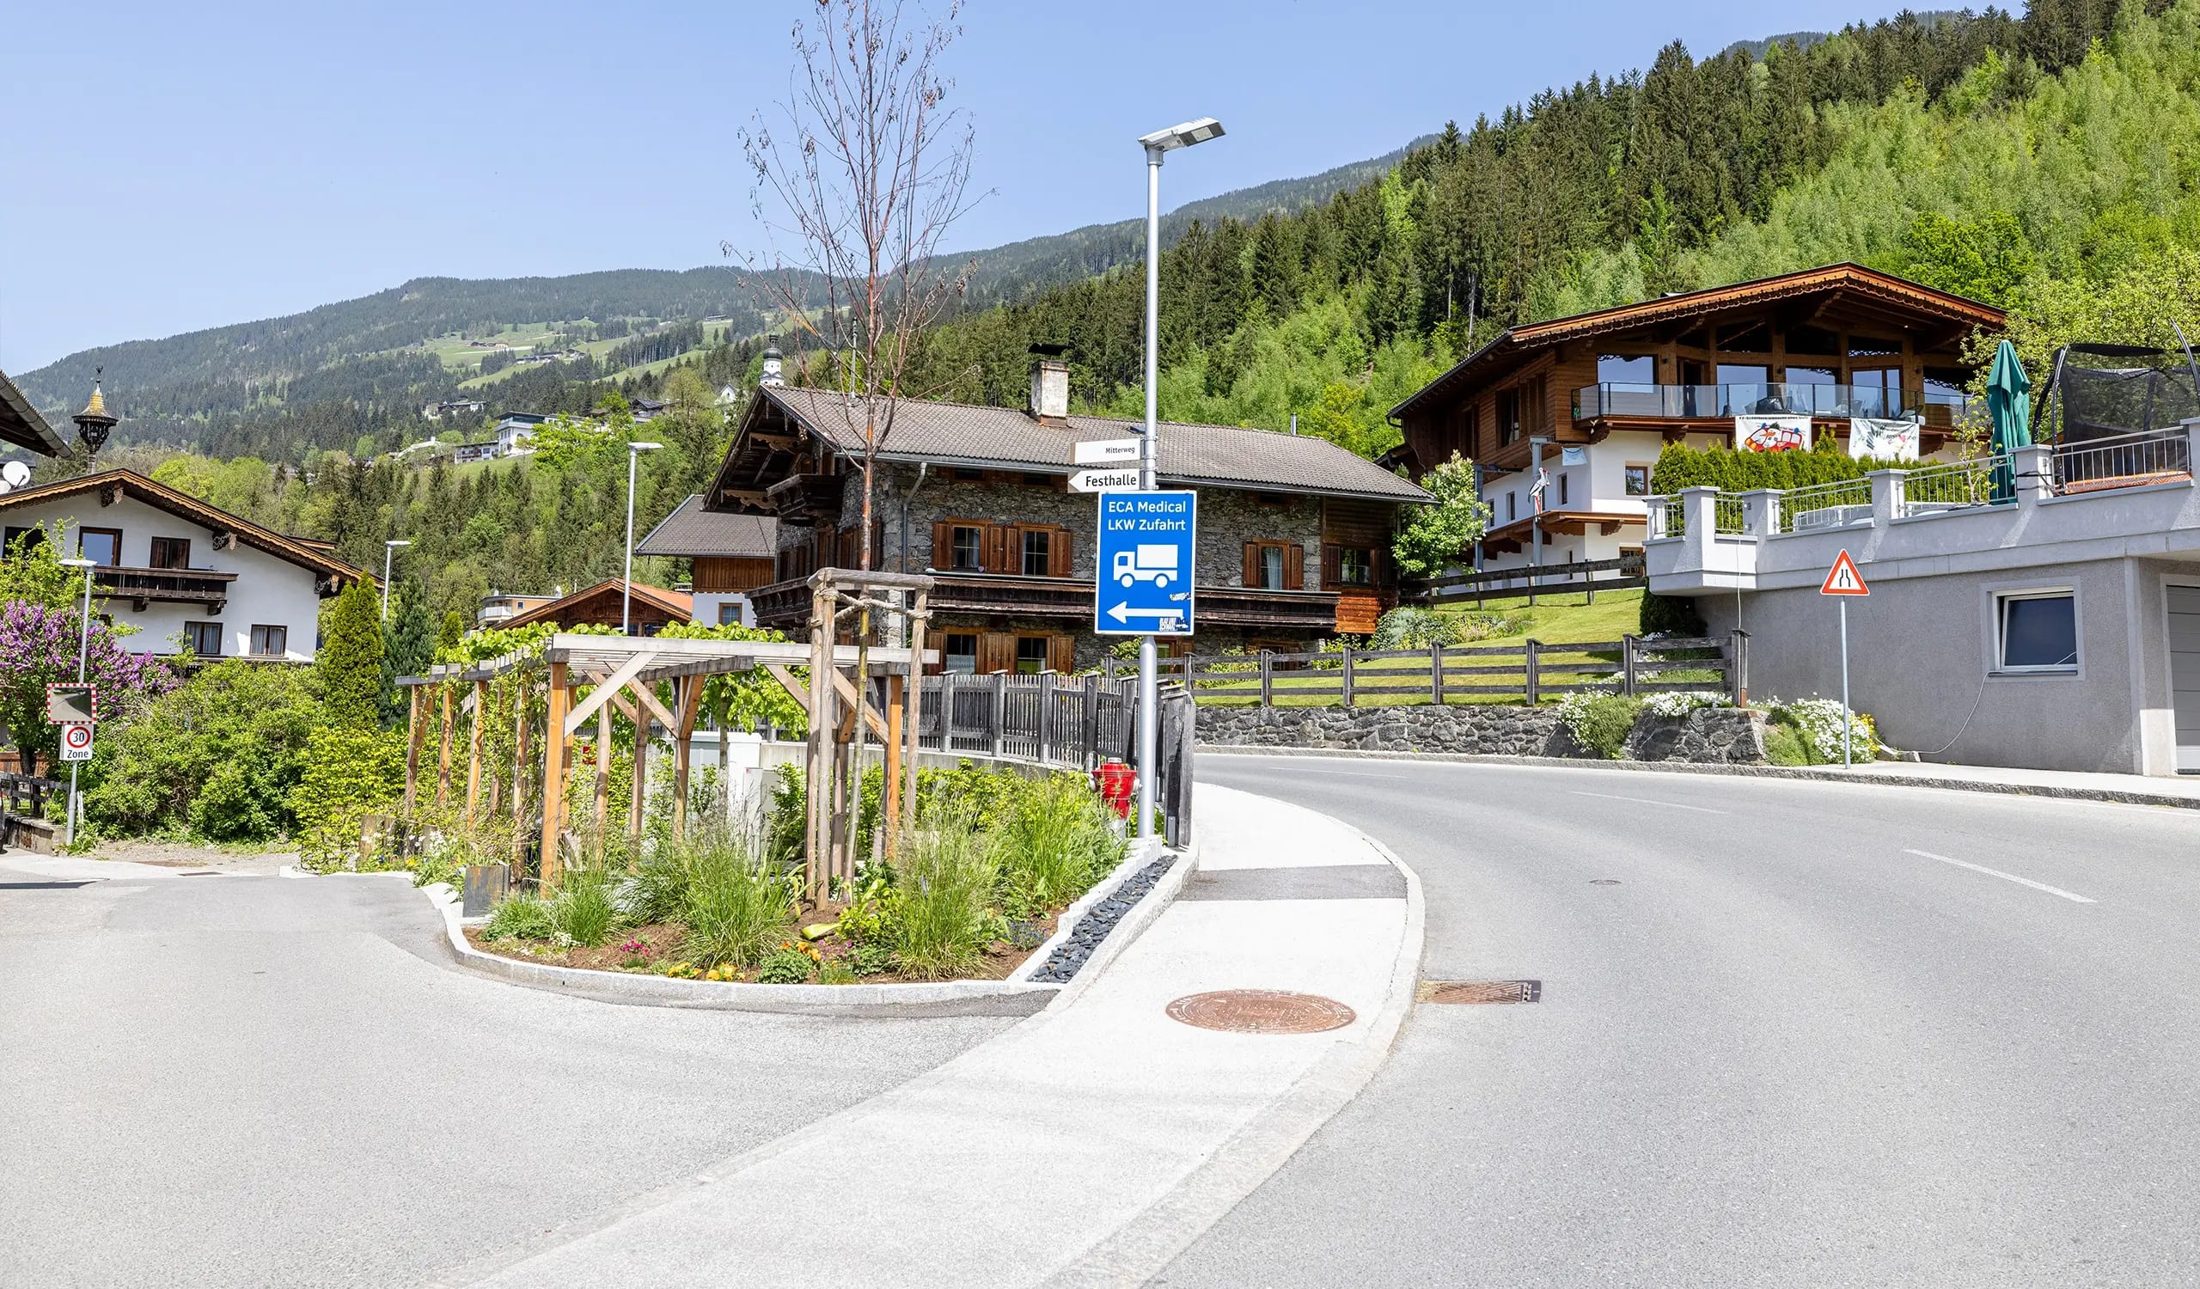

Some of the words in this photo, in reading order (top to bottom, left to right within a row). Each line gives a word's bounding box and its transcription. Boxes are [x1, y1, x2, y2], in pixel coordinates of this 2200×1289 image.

[1105, 446, 1135, 454] Mitterweg
[1085, 474, 1137, 487] Festhalle
[1108, 501, 1134, 513] ECA
[1137, 501, 1186, 513] Medical
[1108, 519, 1136, 531] LKW
[1138, 518, 1186, 531] Zufahrt
[73, 732, 85, 742] 30
[67, 750, 89, 758] Zone
